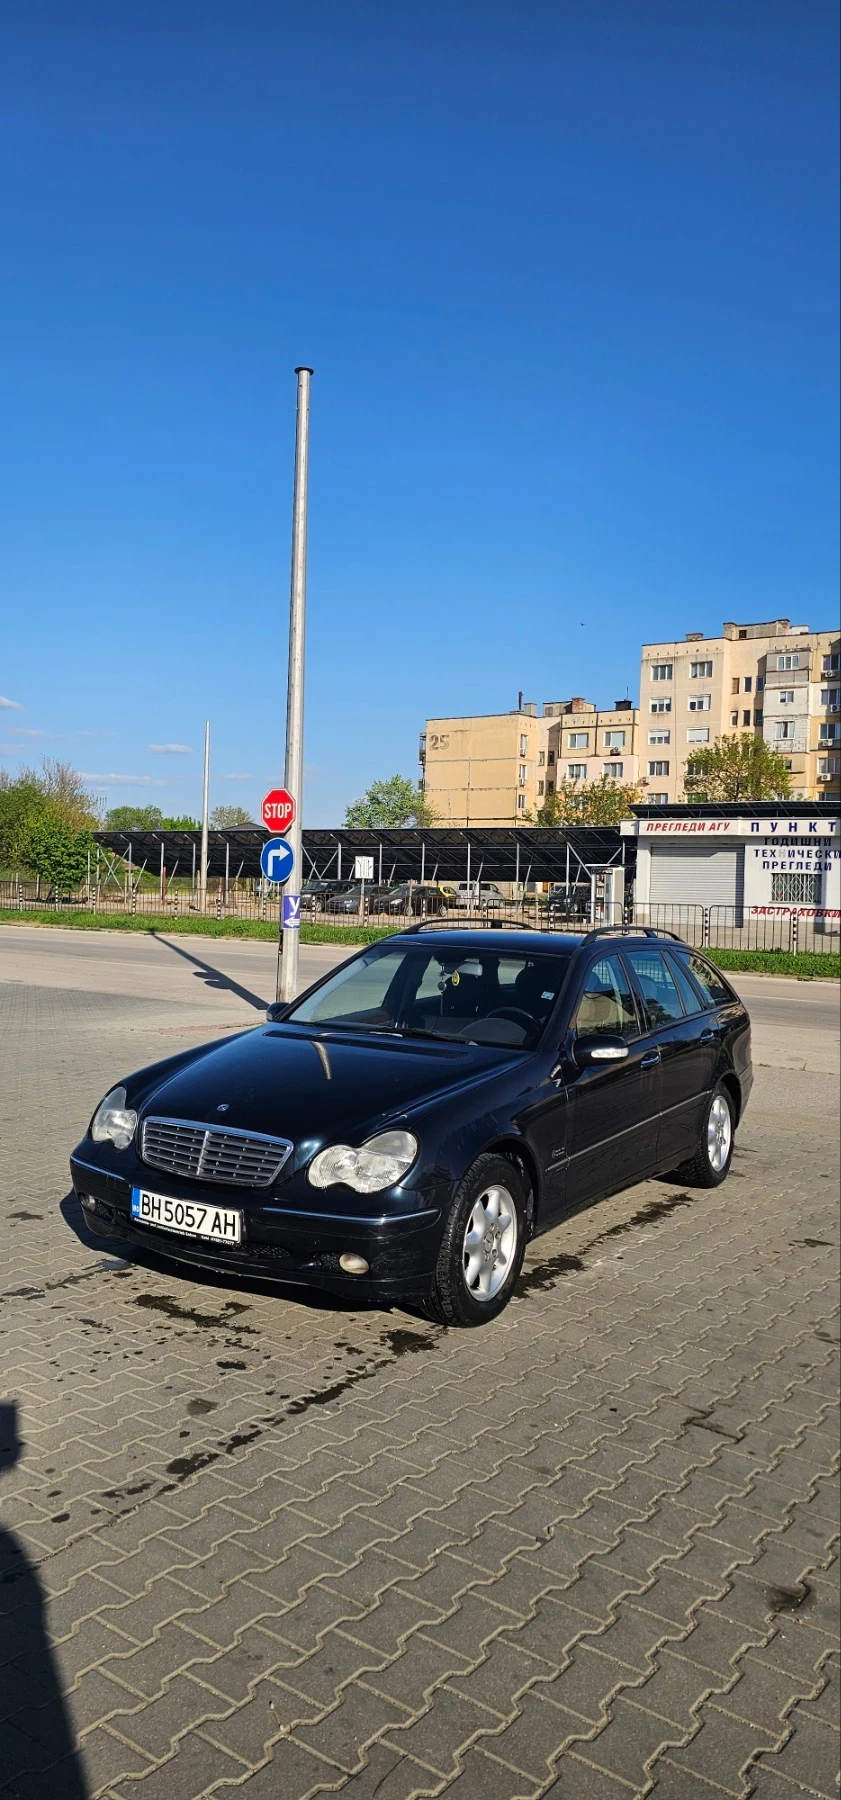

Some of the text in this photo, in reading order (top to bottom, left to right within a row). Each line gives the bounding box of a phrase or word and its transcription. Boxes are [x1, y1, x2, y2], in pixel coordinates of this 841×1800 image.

[430, 734, 449, 751] 25
[264, 803, 292, 819] STOP
[646, 822, 730, 832] ПРЕГЛЕДИ АГУ
[764, 837, 832, 847] ГОДИШНИ
[762, 861, 832, 871] ПРЕГЛЕДИ
[141, 1193, 161, 1220] BH
[164, 1201, 207, 1230] 5057
[211, 1211, 236, 1237] AH
